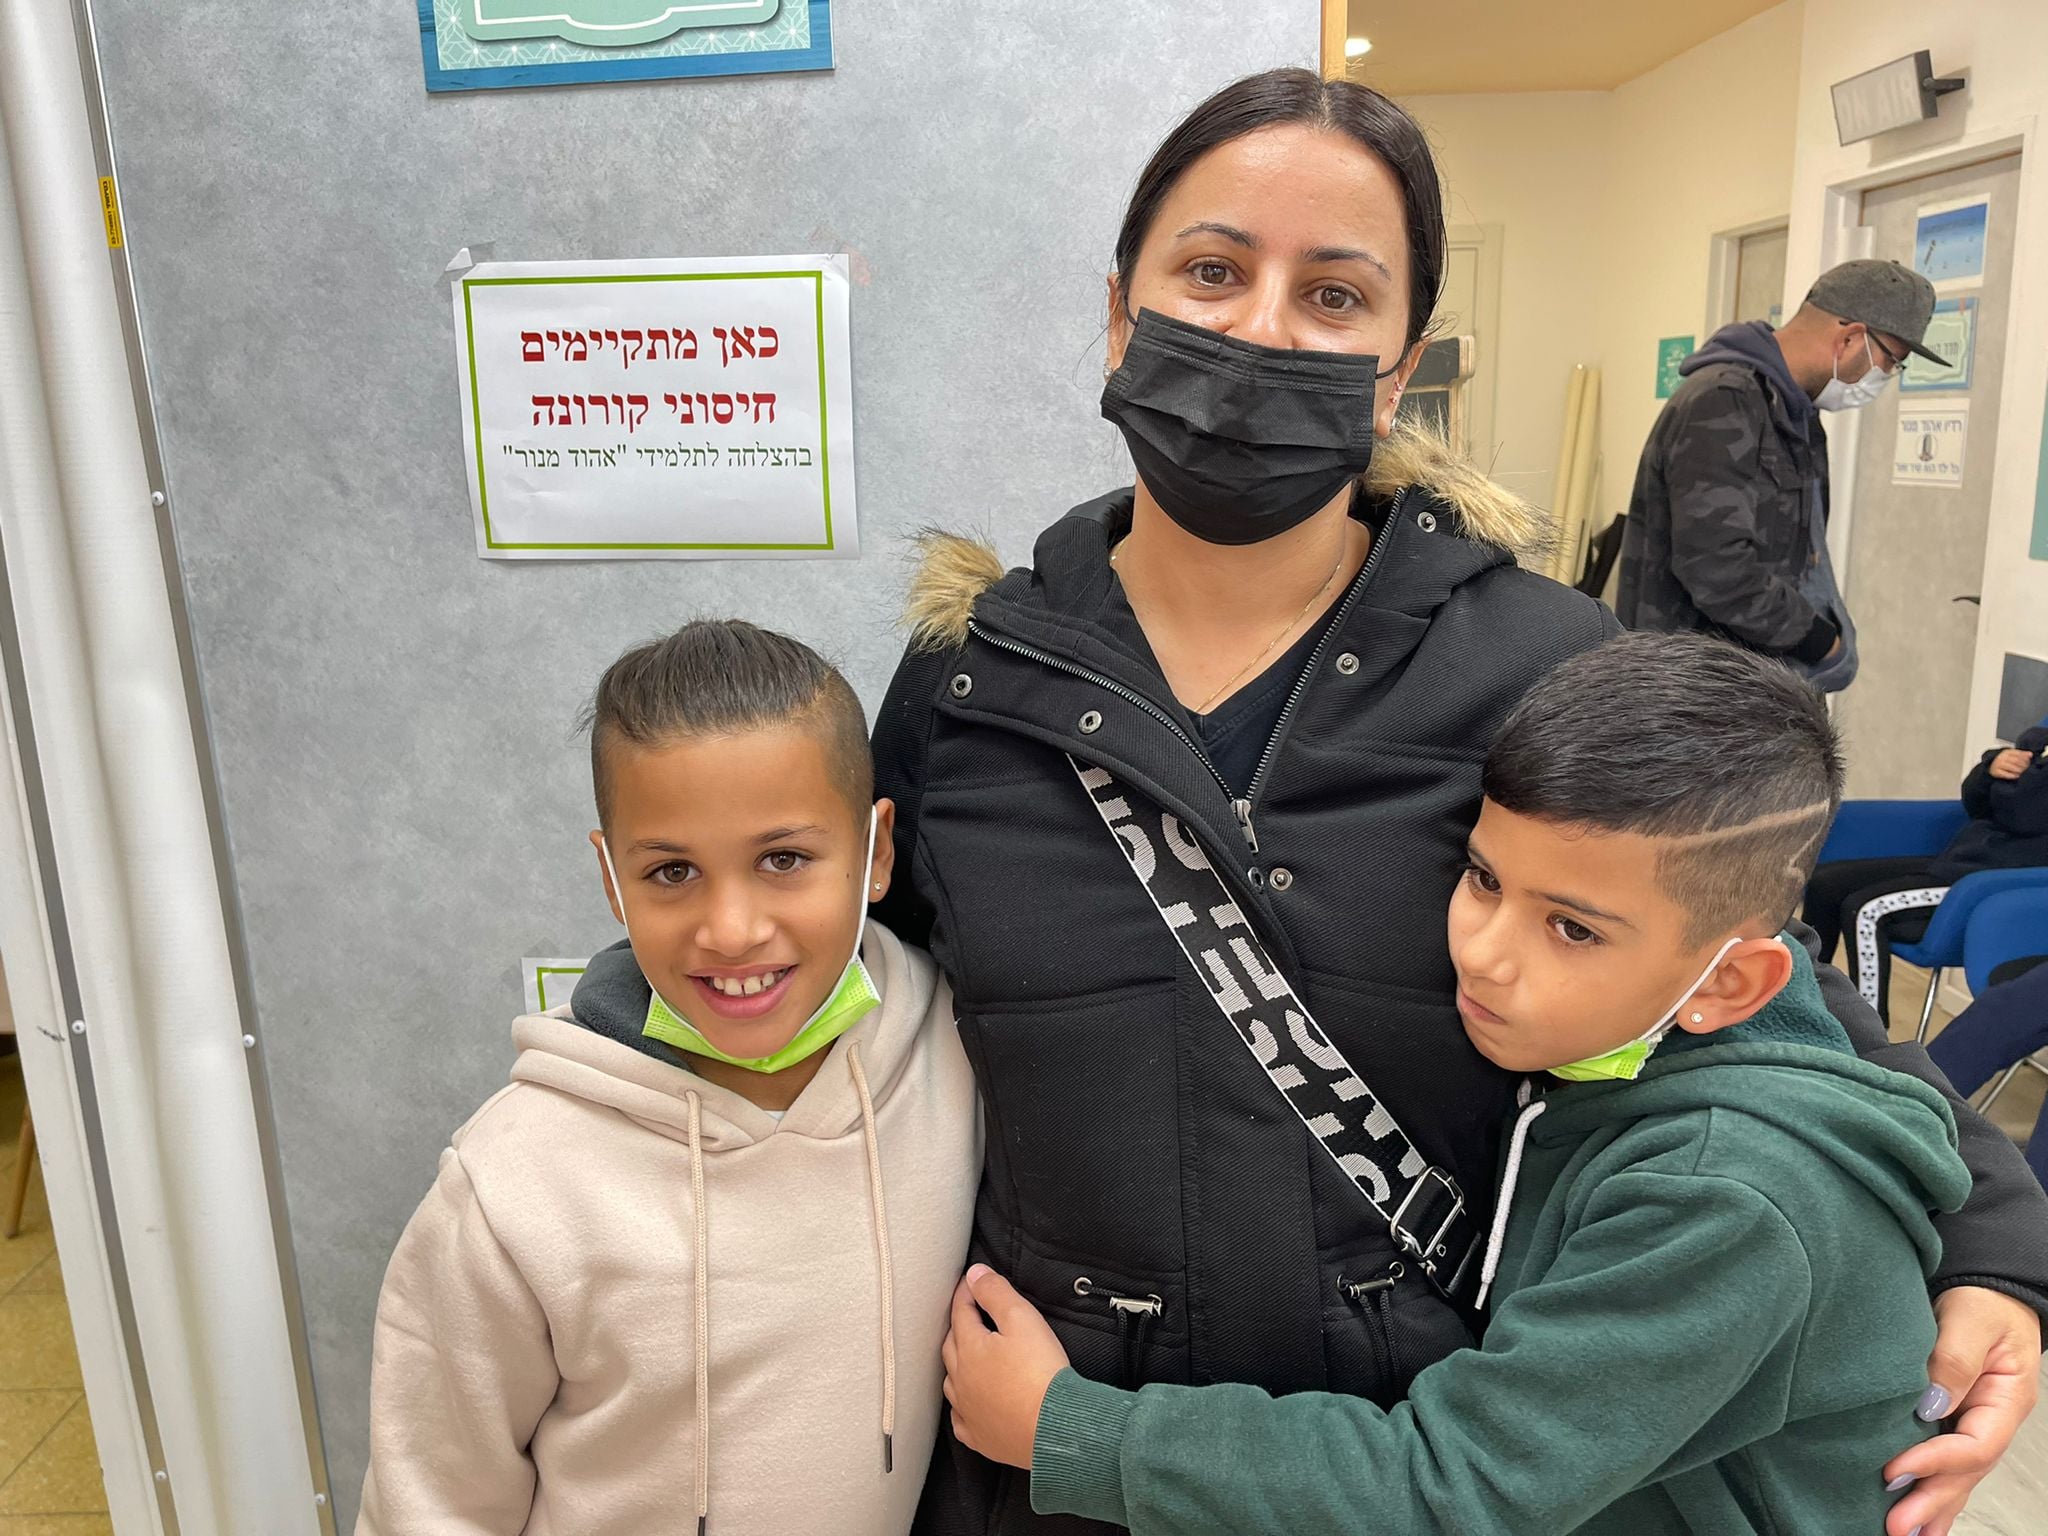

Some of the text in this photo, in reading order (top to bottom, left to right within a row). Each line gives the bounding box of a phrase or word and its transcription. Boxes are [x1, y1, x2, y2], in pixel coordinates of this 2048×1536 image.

[1837, 69, 1921, 133] ON AIR
[520, 325, 779, 370] כאן מתקיימים
[531, 391, 777, 434] חיסוני קורונה
[503, 441, 812, 468] בהצלחה לתלמידי "אהוד מנור"
